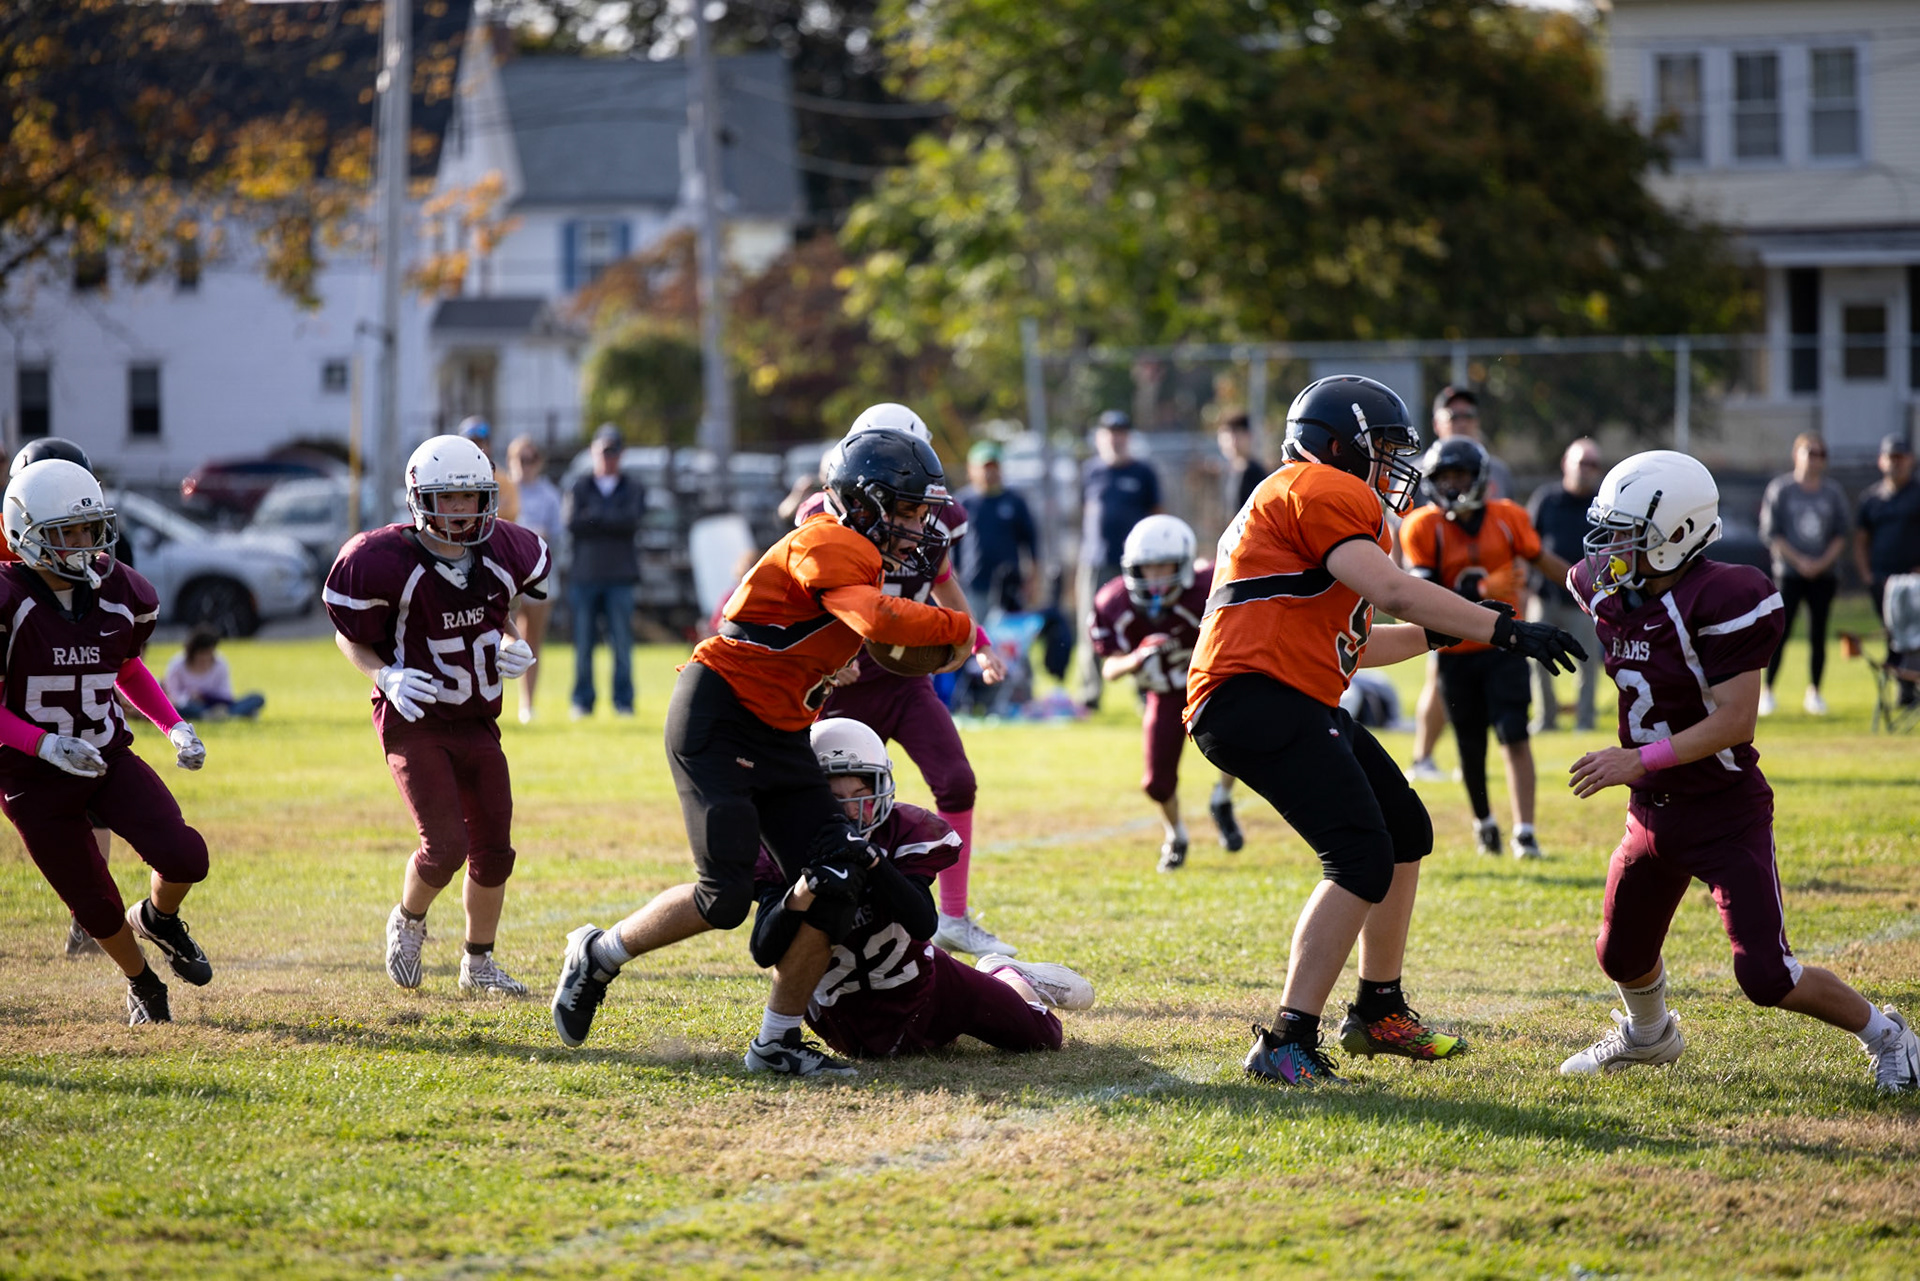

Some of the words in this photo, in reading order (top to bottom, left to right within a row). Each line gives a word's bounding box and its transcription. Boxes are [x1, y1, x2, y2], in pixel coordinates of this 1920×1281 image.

[442, 606, 485, 630] RAMS
[1612, 637, 1651, 662] RAMS
[53, 646, 101, 666] RAMS
[426, 628, 503, 706] 50
[25, 672, 118, 749] 55
[1615, 669, 1673, 743] 2
[813, 922, 920, 1007] 22
